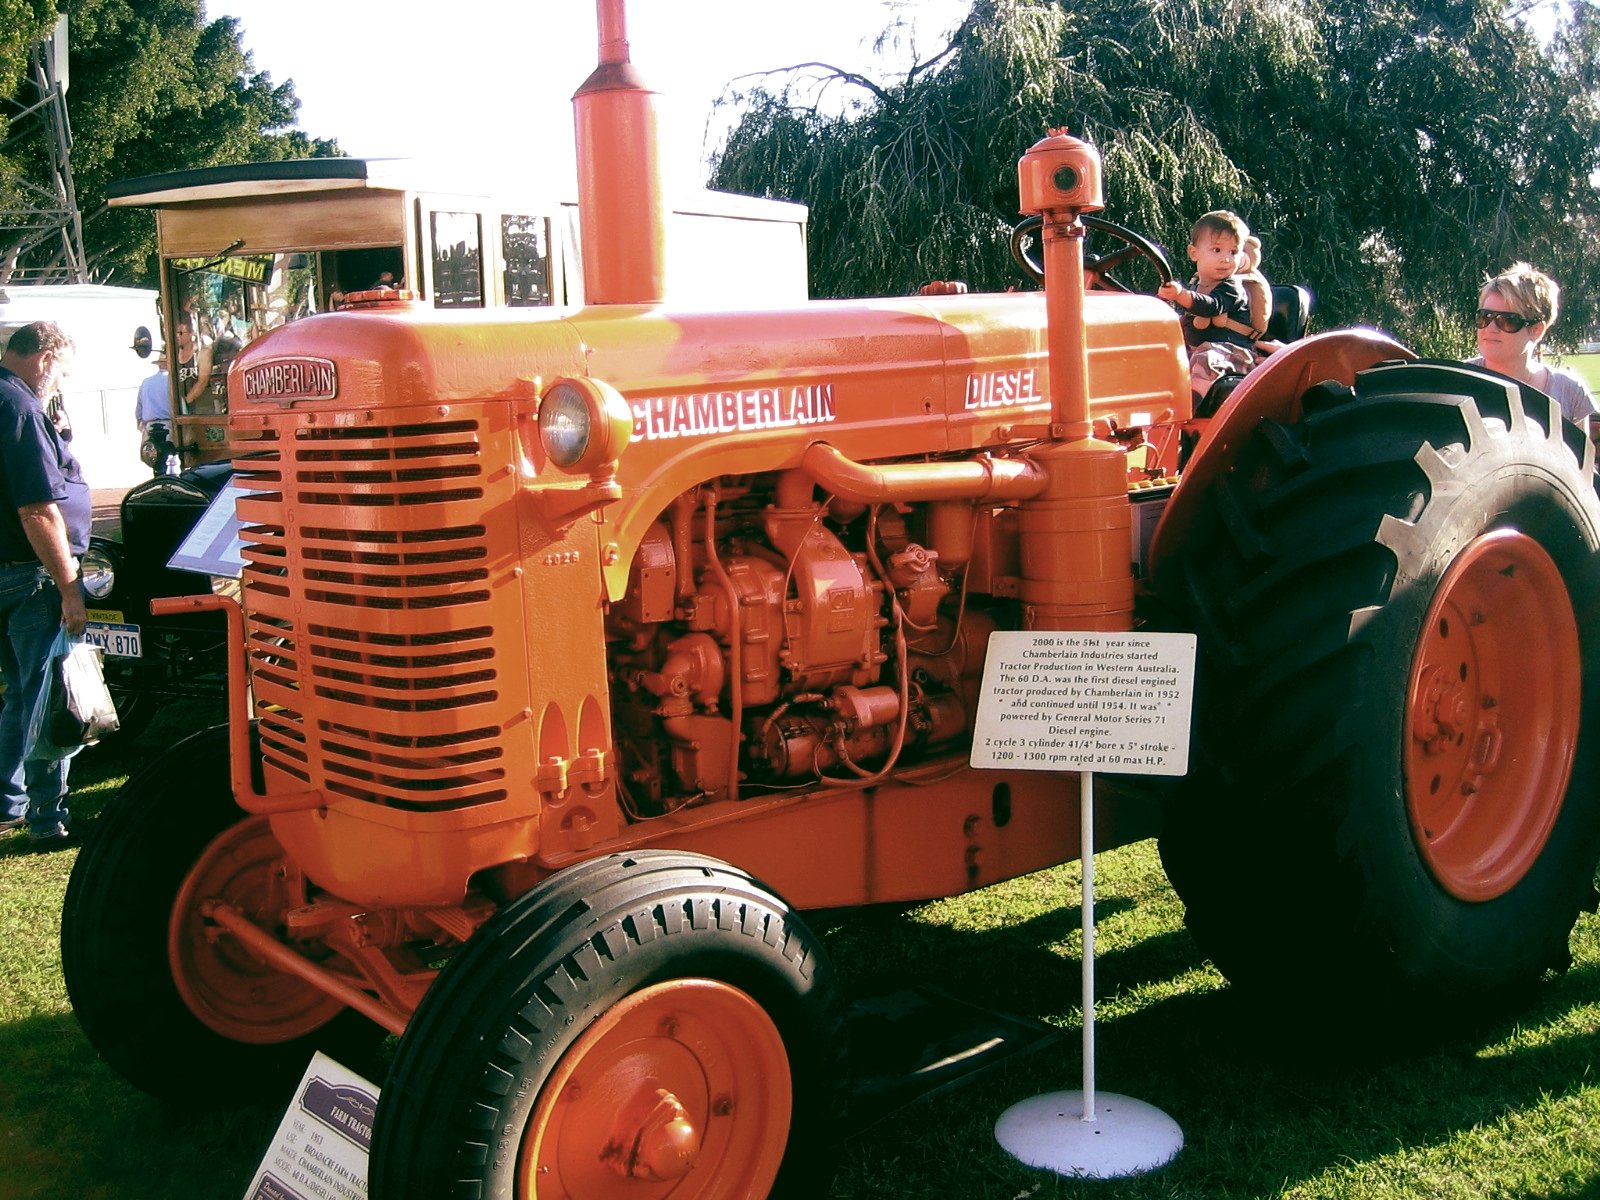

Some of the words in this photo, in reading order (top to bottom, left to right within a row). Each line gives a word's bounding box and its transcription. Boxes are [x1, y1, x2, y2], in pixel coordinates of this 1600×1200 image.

[245, 363, 333, 396] CHAMBERLAIN
[965, 367, 1042, 410] DIESEL
[630, 384, 837, 442] CHAMBERLAIN
[293, 601, 310, 700] DIESEL
[1032, 638, 1055, 647] 2000
[1056, 638, 1064, 646] is
[1066, 638, 1081, 647] the
[1105, 641, 1125, 649] year
[1127, 639, 1151, 648] since
[1022, 649, 1078, 659] Chamberlain
[1080, 650, 1124, 660] Industries
[1126, 652, 1159, 660] started
[999, 662, 1032, 671] Tractor
[1033, 662, 1082, 671] Production
[1084, 663, 1094, 671] in
[1096, 663, 1134, 672] Western
[1136, 664, 1180, 674] Australia.
[999, 673, 1016, 683] The
[1017, 674, 1029, 683] 60
[1031, 674, 1052, 683] D.A.
[1074, 674, 1089, 684] the
[1091, 675, 1109, 684] first
[1111, 675, 1138, 685] diesel
[1140, 677, 1177, 688] engined
[993, 687, 1024, 695] tractor
[1025, 686, 1069, 698] produced
[1070, 687, 1081, 697] by
[1084, 687, 1142, 698] Chamberlain
[1144, 689, 1154, 698] in
[1157, 690, 1180, 699] 1952
[1010, 698, 1028, 708] and
[1030, 699, 1075, 709] continued
[1077, 700, 1099, 709] until
[1102, 701, 1127, 710] 1954.
[1129, 702, 1137, 710] It
[1000, 712, 1040, 722] powered
[1041, 712, 1052, 723] by
[1055, 713, 1092, 722] General
[1093, 714, 1123, 723] Motor
[1124, 714, 1152, 724] Series
[1155, 716, 1166, 724] 71
[1048, 725, 1077, 735] Diesel
[1079, 727, 1112, 738] engine.
[985, 737, 991, 746] 2
[993, 737, 1017, 749] cycle
[1019, 738, 1026, 747] 3
[1028, 738, 1066, 749] cylinder
[1095, 740, 1117, 750] bore
[1140, 742, 1169, 752] stroke
[992, 751, 1014, 760] 1200
[1023, 752, 1046, 761] 1300
[1048, 754, 1067, 764] rpm
[1069, 753, 1095, 763] rated
[1096, 755, 1106, 763] at
[1108, 755, 1121, 764] 60
[1123, 757, 1142, 765] max
[1145, 756, 1166, 766] H.P.
[330, 1105, 348, 1125] FARM
[299, 1156, 333, 1186] CHAMBERLAIN
[334, 1163, 350, 1180] FARM
[349, 1173, 369, 1194] TRACTO
